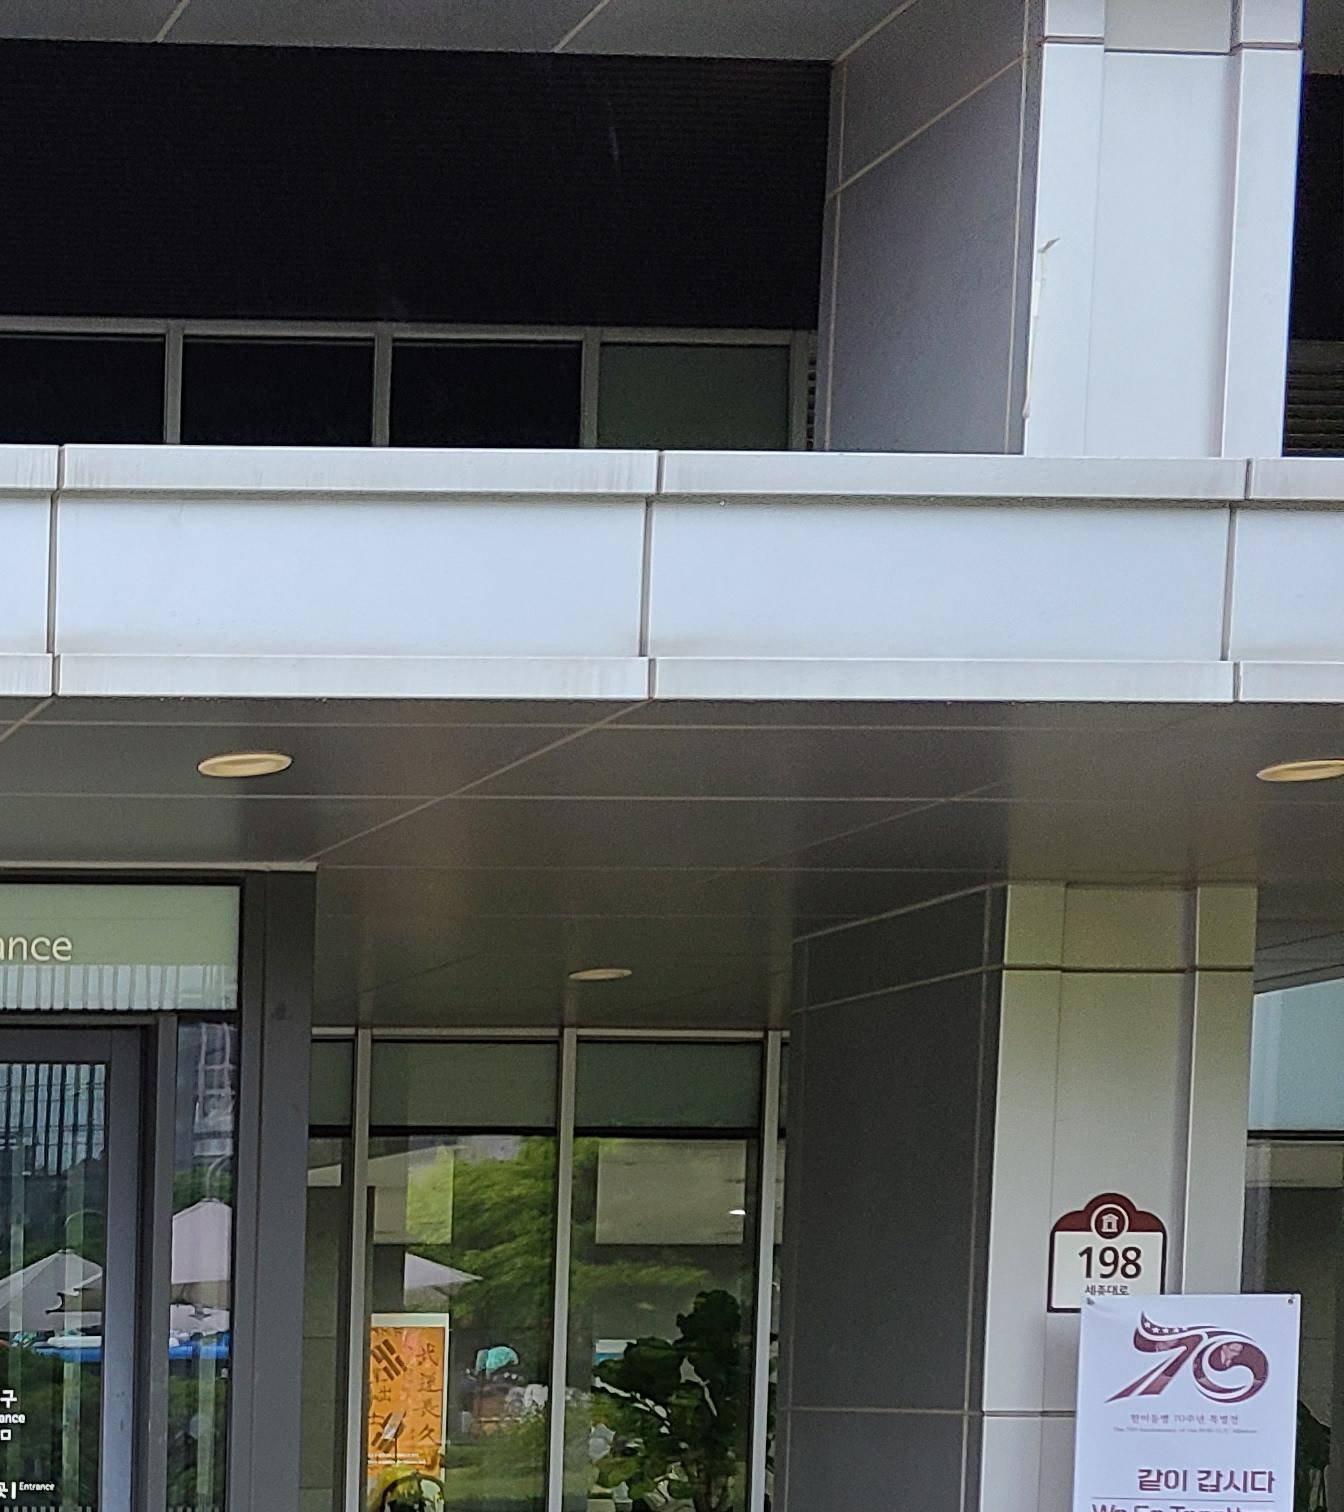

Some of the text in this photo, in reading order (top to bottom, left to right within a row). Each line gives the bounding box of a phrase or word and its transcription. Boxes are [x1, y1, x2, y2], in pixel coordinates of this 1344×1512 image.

[1078, 1246, 1142, 1279] 198
[19, 1482, 55, 1493] Entrance
[1138, 1469, 1275, 1493] 같이 갑시다
